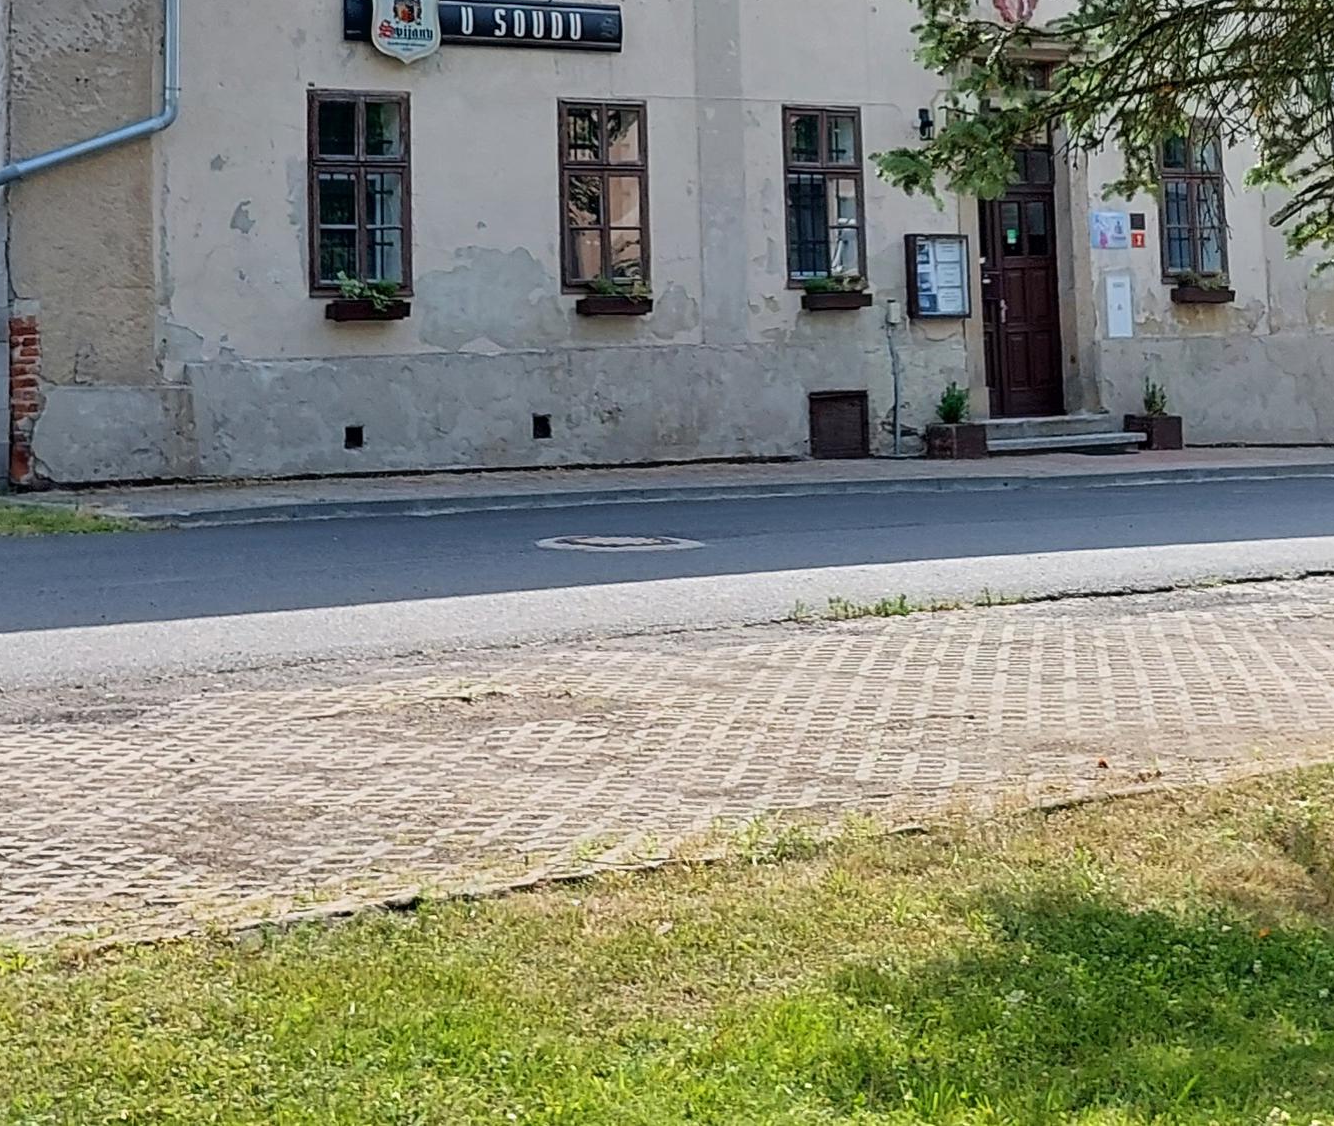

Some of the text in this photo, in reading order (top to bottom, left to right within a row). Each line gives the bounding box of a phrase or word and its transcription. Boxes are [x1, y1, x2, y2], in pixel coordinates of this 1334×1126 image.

[378, 19, 433, 41] Svijany
[461, 6, 582, 40] U SOUDU
